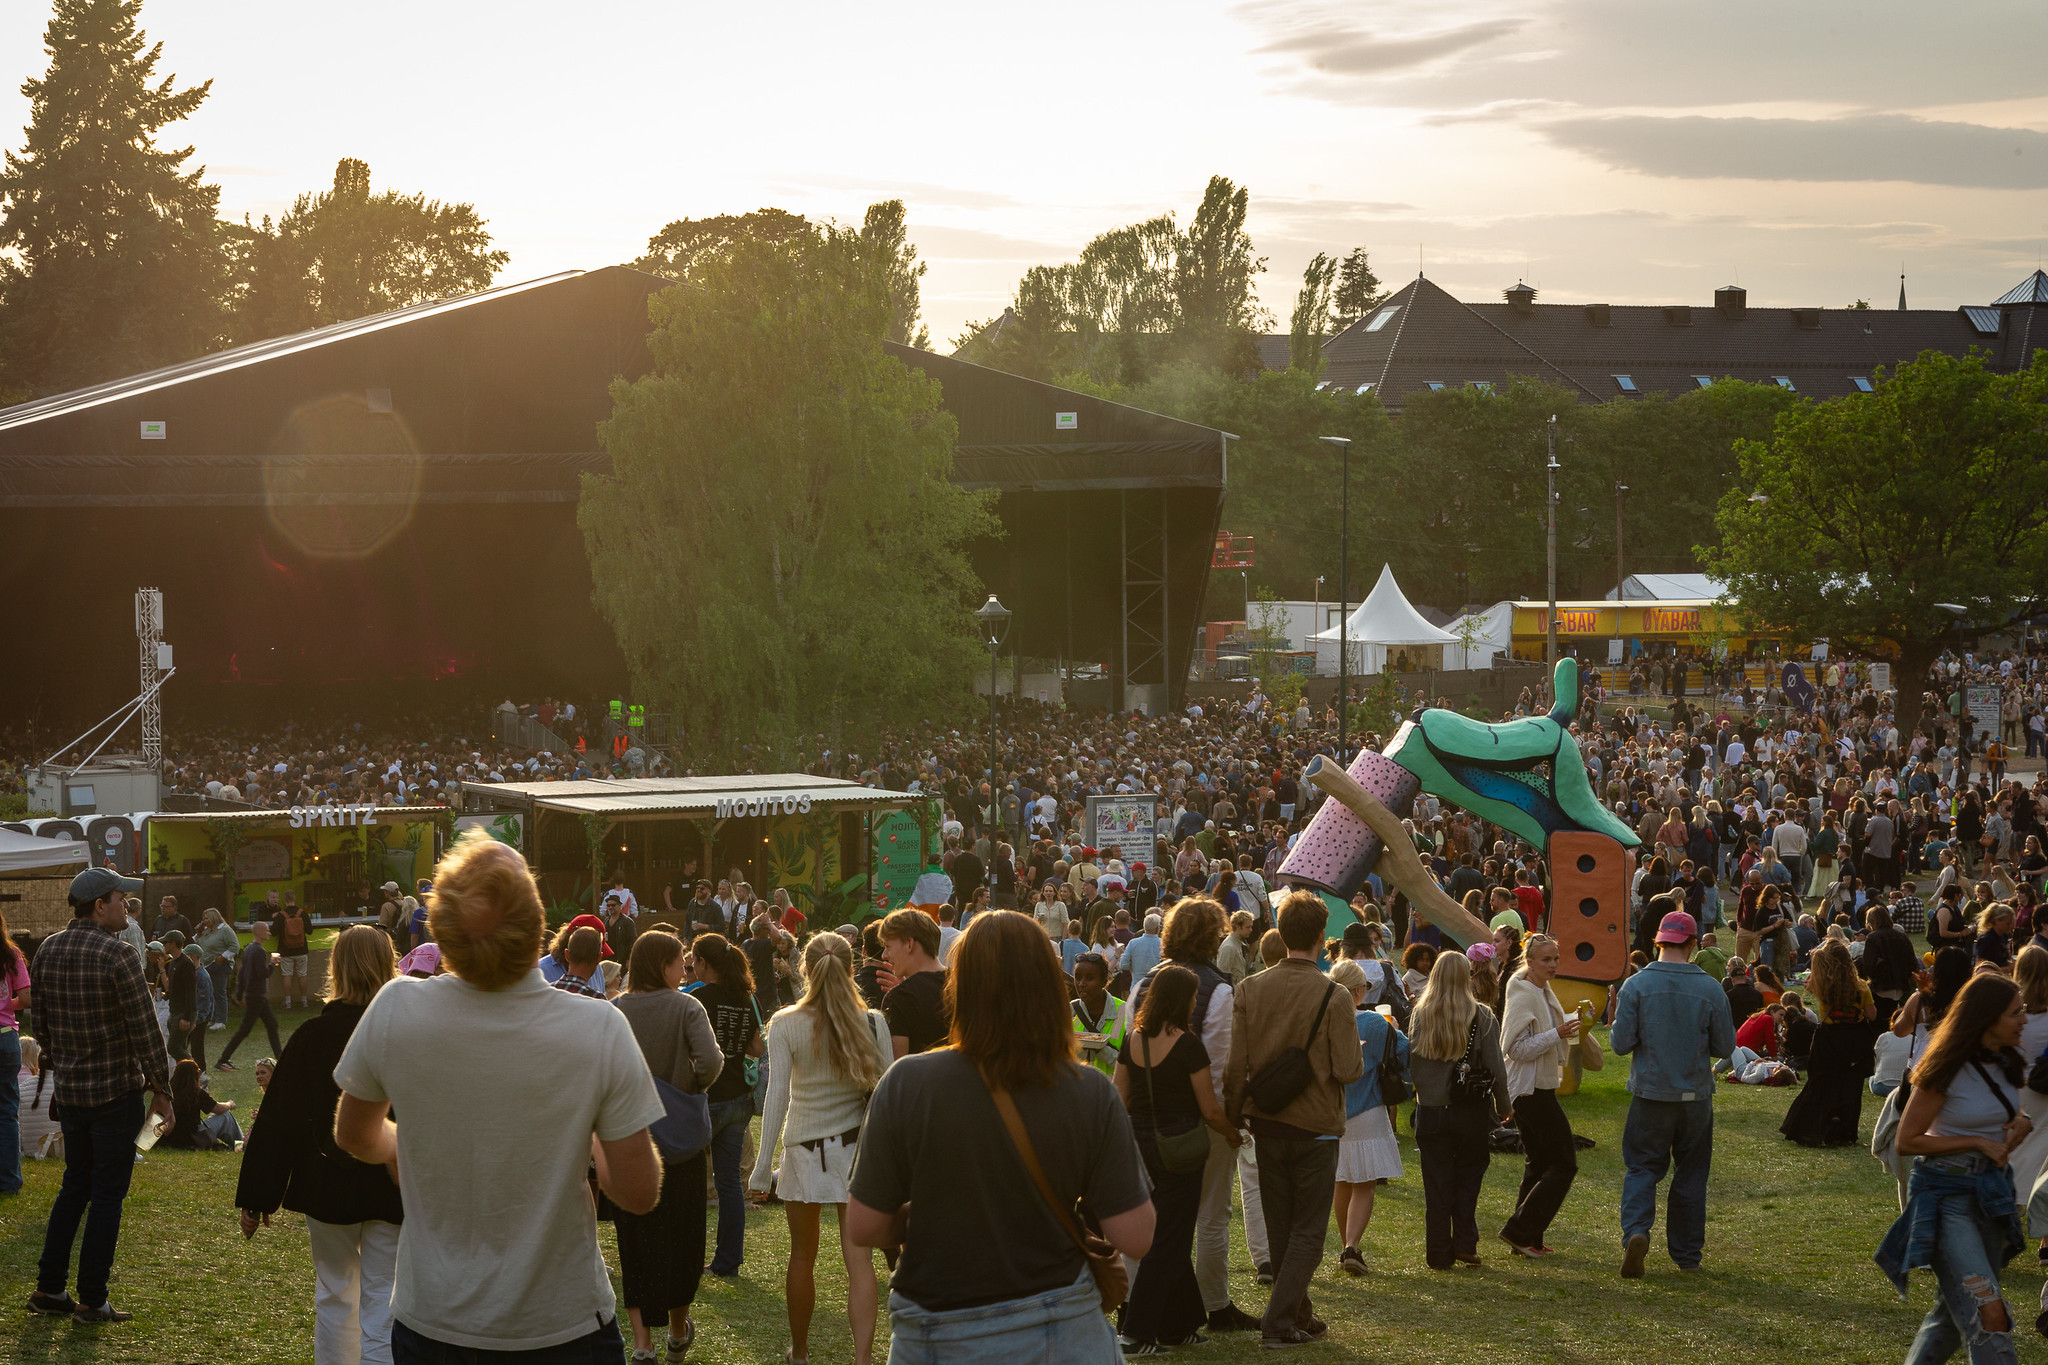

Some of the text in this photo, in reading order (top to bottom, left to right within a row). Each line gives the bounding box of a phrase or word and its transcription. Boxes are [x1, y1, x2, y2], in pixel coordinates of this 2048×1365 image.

[1537, 609, 1597, 633] ØABAR
[1642, 608, 1701, 632] ØYABAR
[289, 803, 378, 828] SPRITZ
[715, 793, 812, 819] MOJITOS
